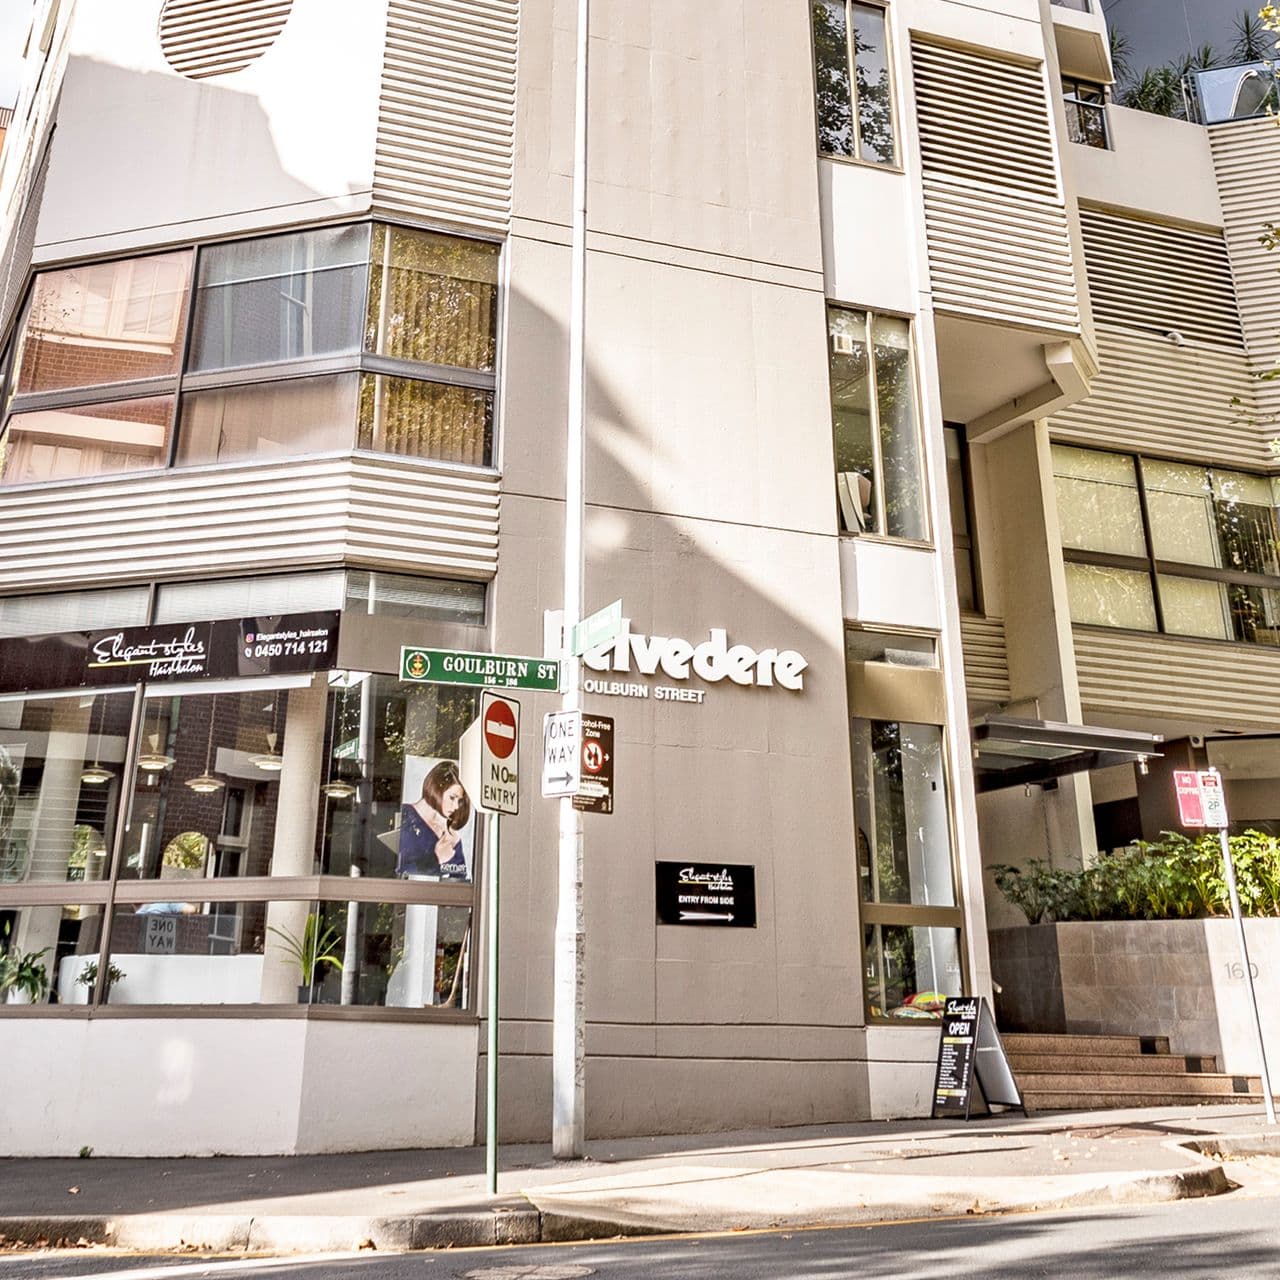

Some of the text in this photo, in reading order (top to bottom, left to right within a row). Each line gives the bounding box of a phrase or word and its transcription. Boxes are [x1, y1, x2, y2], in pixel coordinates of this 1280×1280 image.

[93, 632, 157, 663] Elegant
[255, 640, 328, 657] 0450 714 121
[443, 656, 557, 680] GOULBURN ST
[584, 679, 705, 703] OULBURN STREET
[549, 720, 574, 739] ONE
[580, 719, 611, 731] cohol-Free
[548, 745, 575, 763] WAY
[491, 764, 510, 783] NO
[484, 785, 517, 806] ENTRY
[1208, 801, 1220, 810] 2P
[678, 895, 700, 903] ENTRY
[700, 895, 718, 904] FROM
[948, 1022, 970, 1035] OPEN
